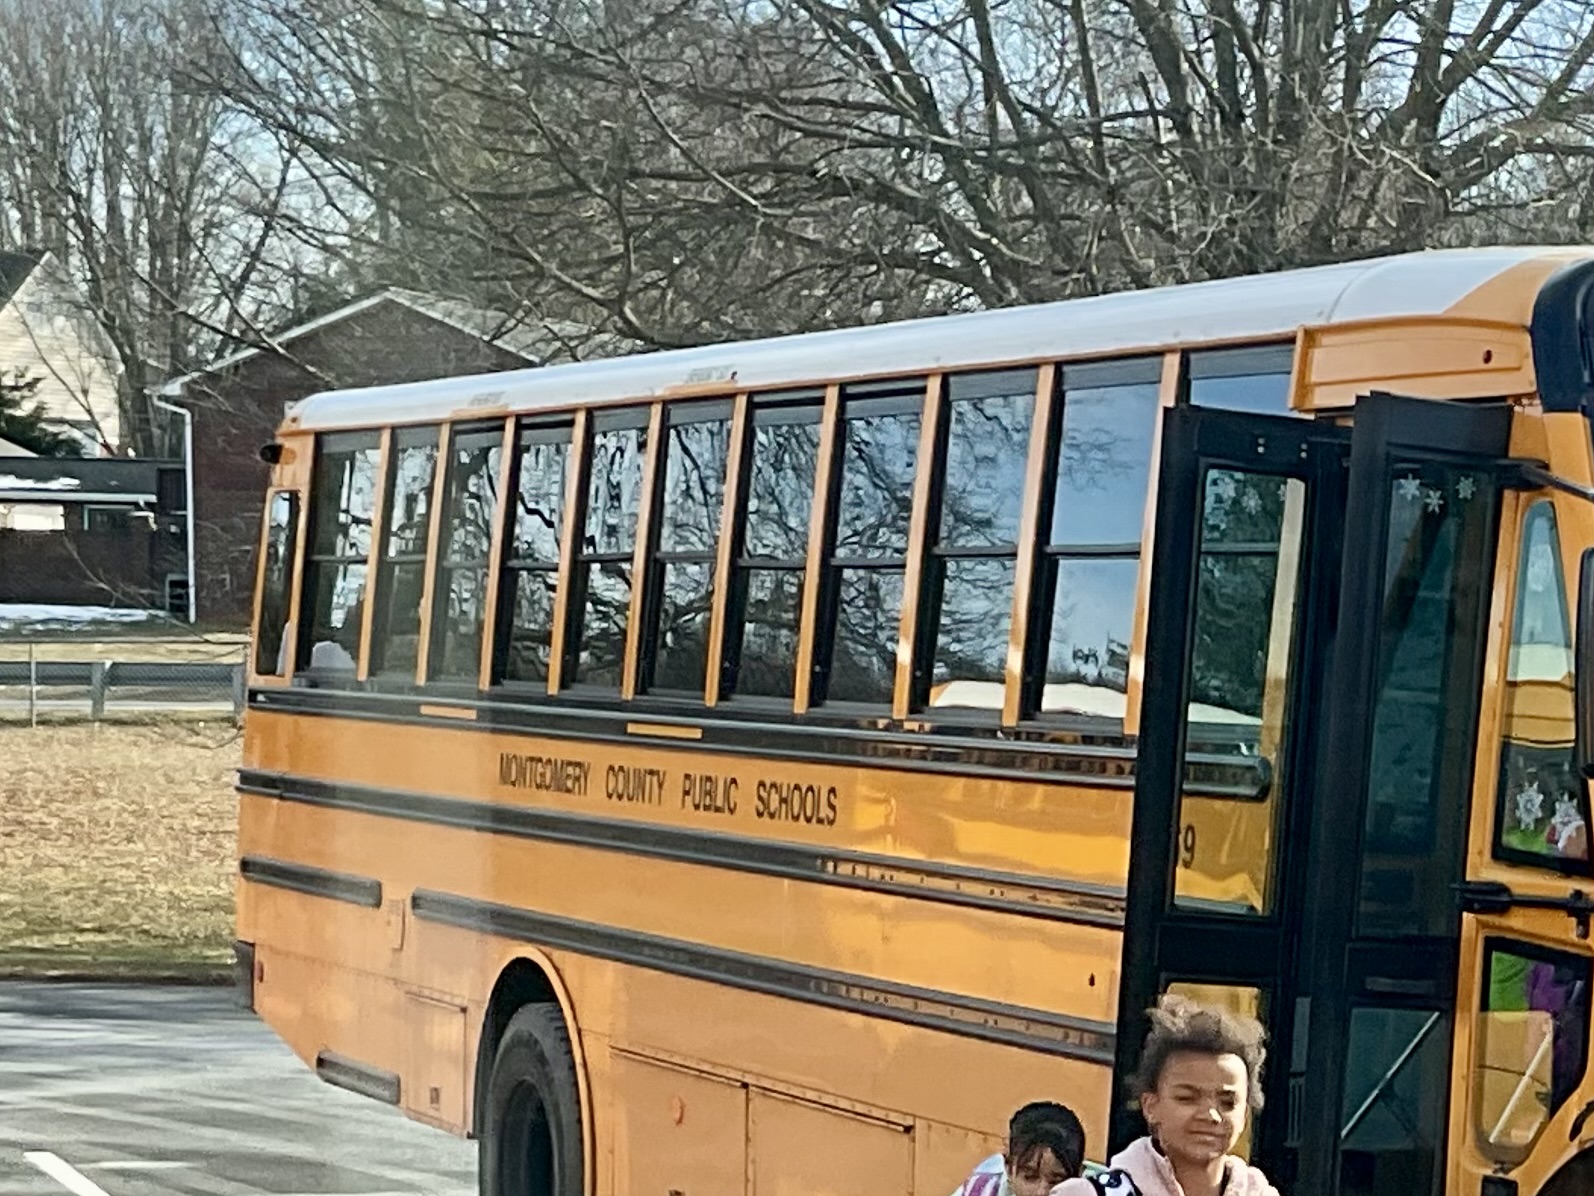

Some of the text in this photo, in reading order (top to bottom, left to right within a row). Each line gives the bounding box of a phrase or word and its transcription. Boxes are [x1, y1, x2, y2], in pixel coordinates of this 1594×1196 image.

[499, 752, 838, 827] MONTGOMERY COUNTY PUBLIC SCHOOLS
